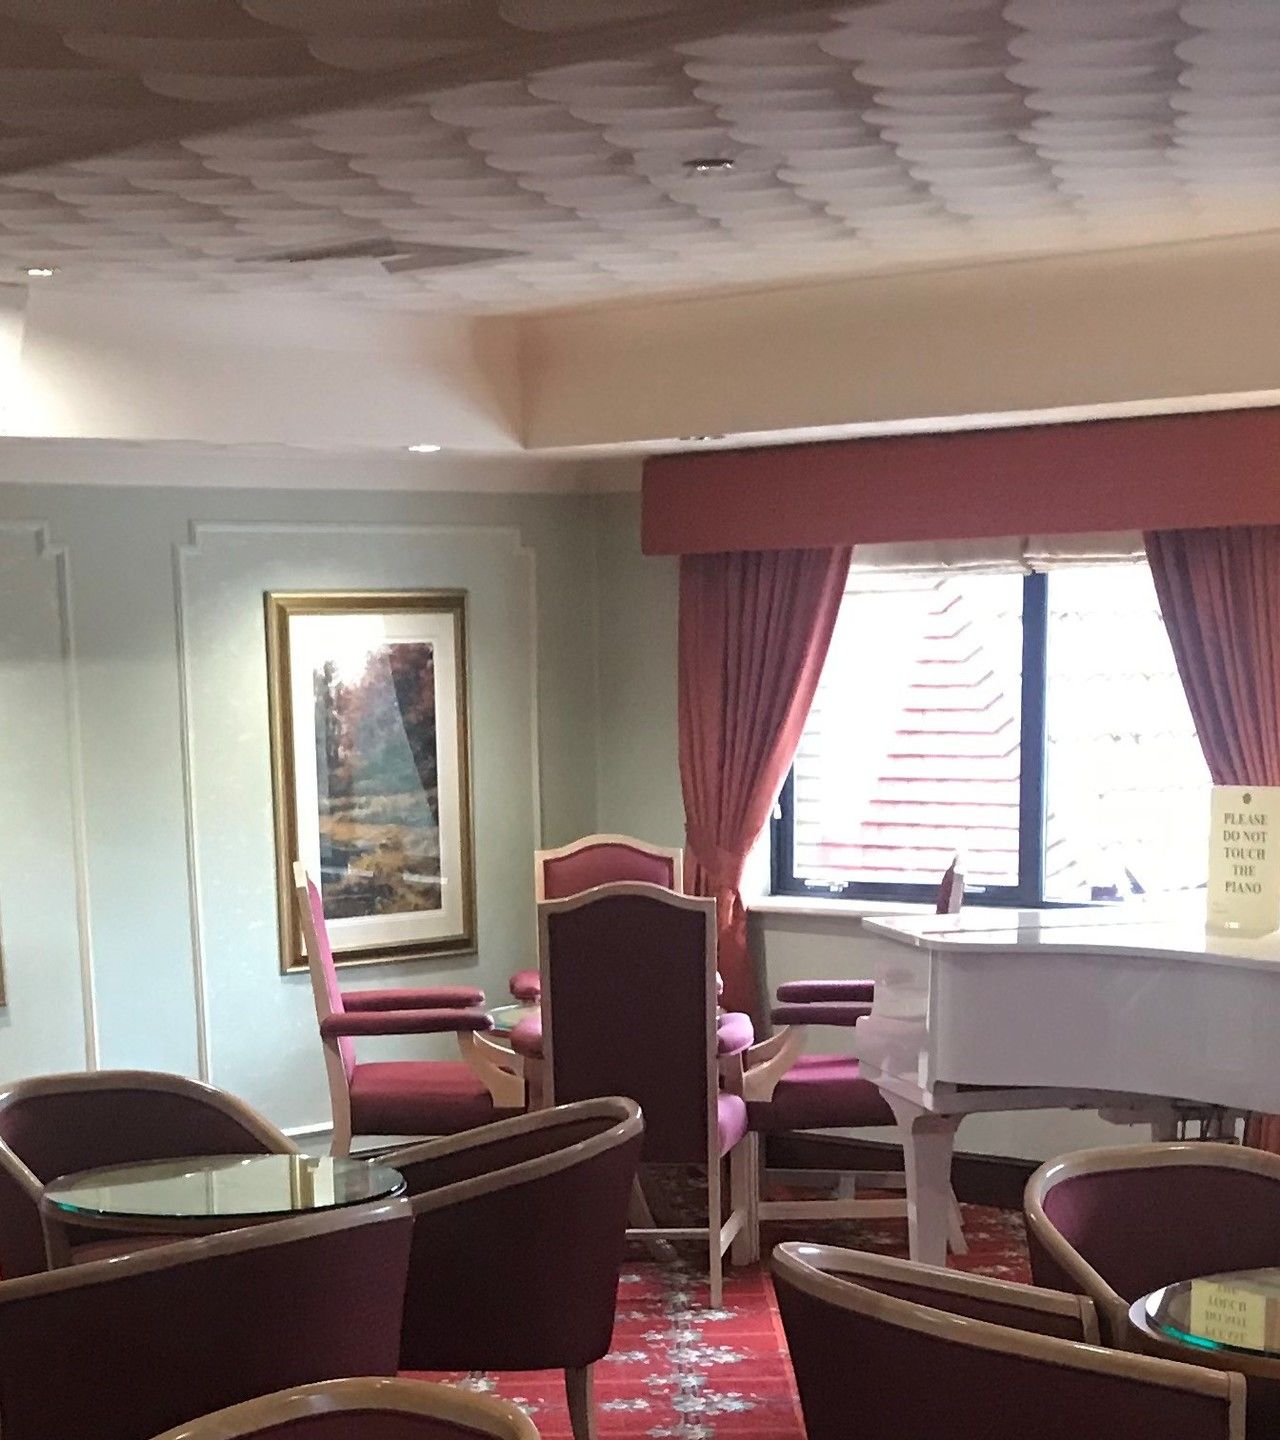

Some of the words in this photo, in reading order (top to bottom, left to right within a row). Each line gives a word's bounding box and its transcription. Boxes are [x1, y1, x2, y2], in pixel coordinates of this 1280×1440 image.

[1223, 812, 1268, 826] PLEASE
[1223, 830, 1240, 842] DO
[1243, 831, 1268, 843] NOT
[1223, 847, 1266, 860] TOUCH
[1233, 864, 1256, 877] THE
[1225, 881, 1262, 894] PIANO
